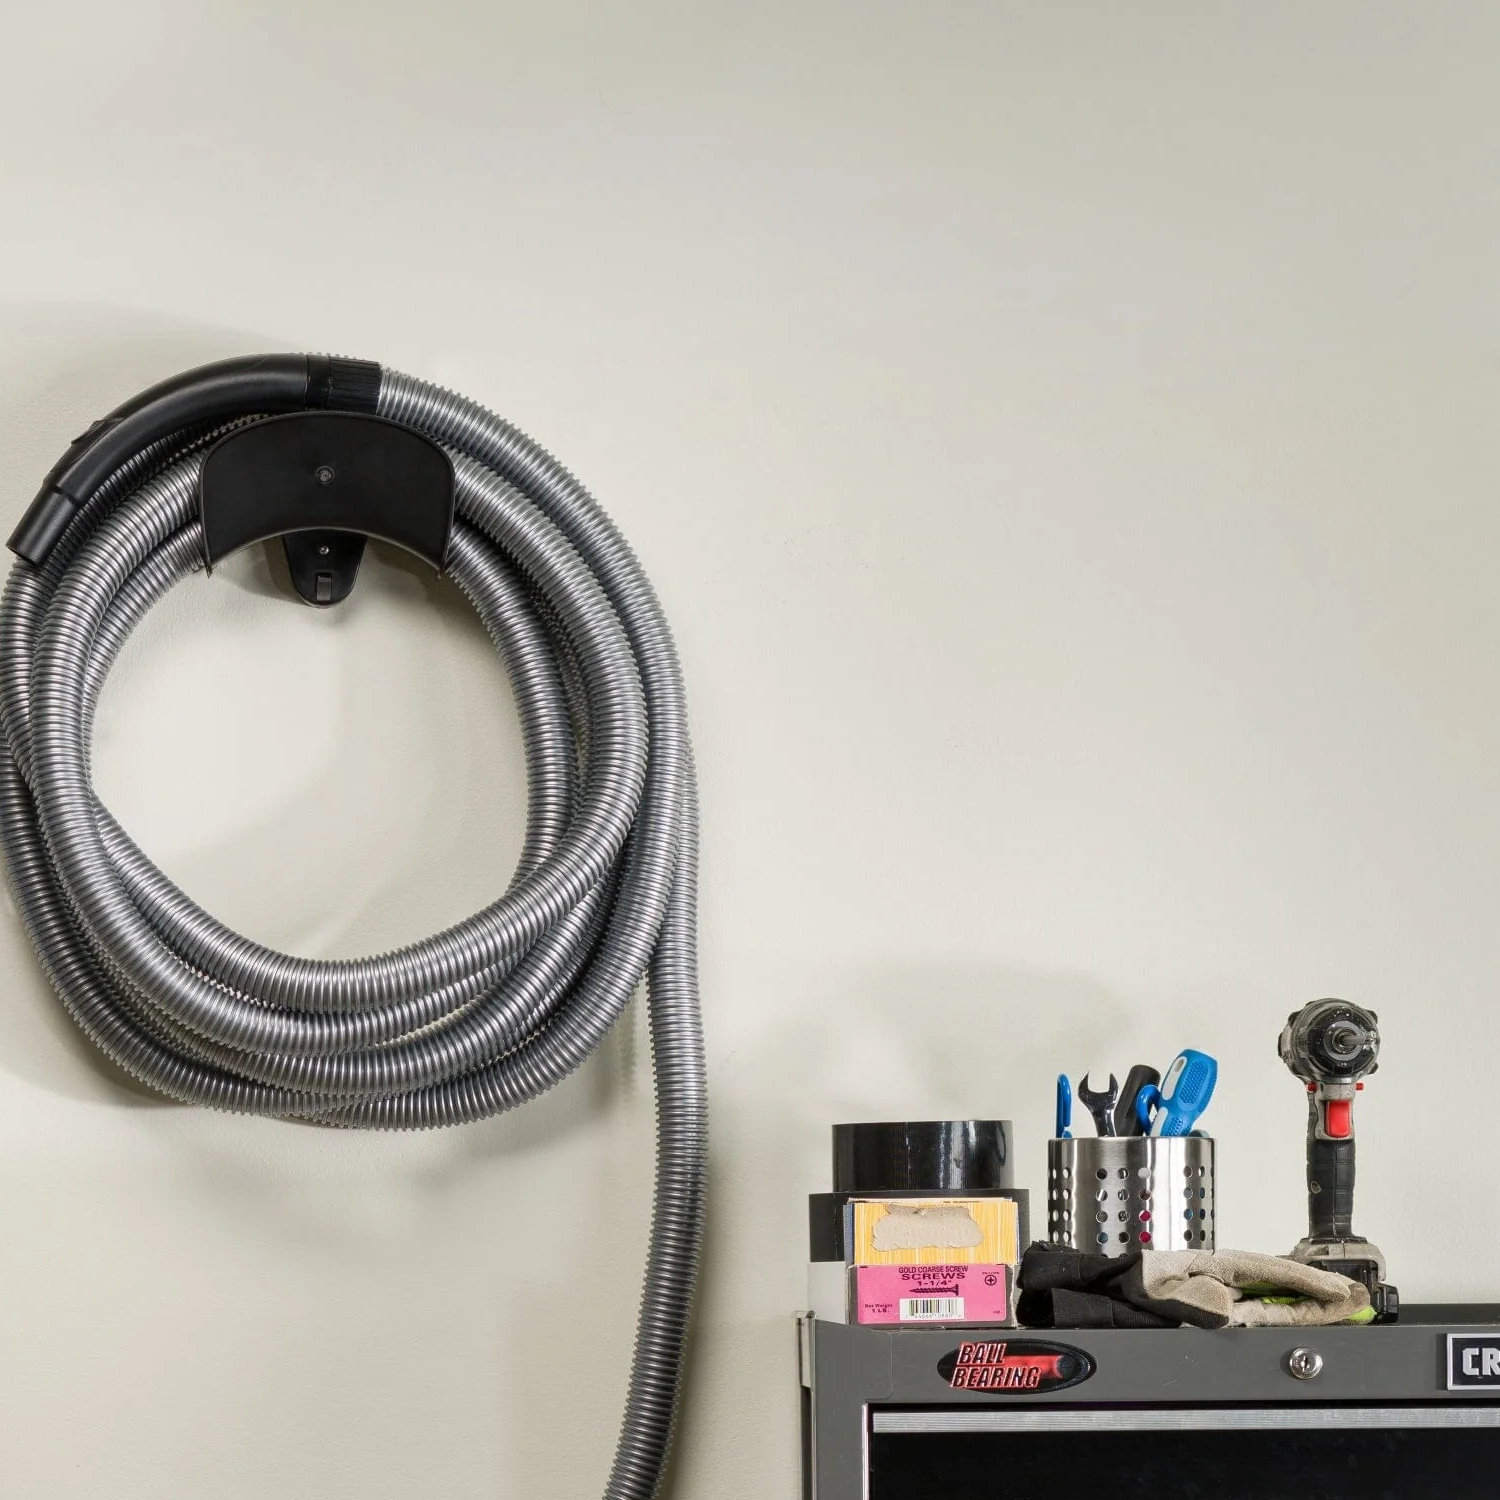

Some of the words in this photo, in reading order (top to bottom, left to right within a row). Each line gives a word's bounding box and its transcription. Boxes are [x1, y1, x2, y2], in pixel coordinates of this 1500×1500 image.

[901, 1272, 966, 1281] SCREWS
[945, 1265, 968, 1273] SCREW
[956, 1342, 1007, 1365] BALL
[950, 1366, 1042, 1389] BEARING
